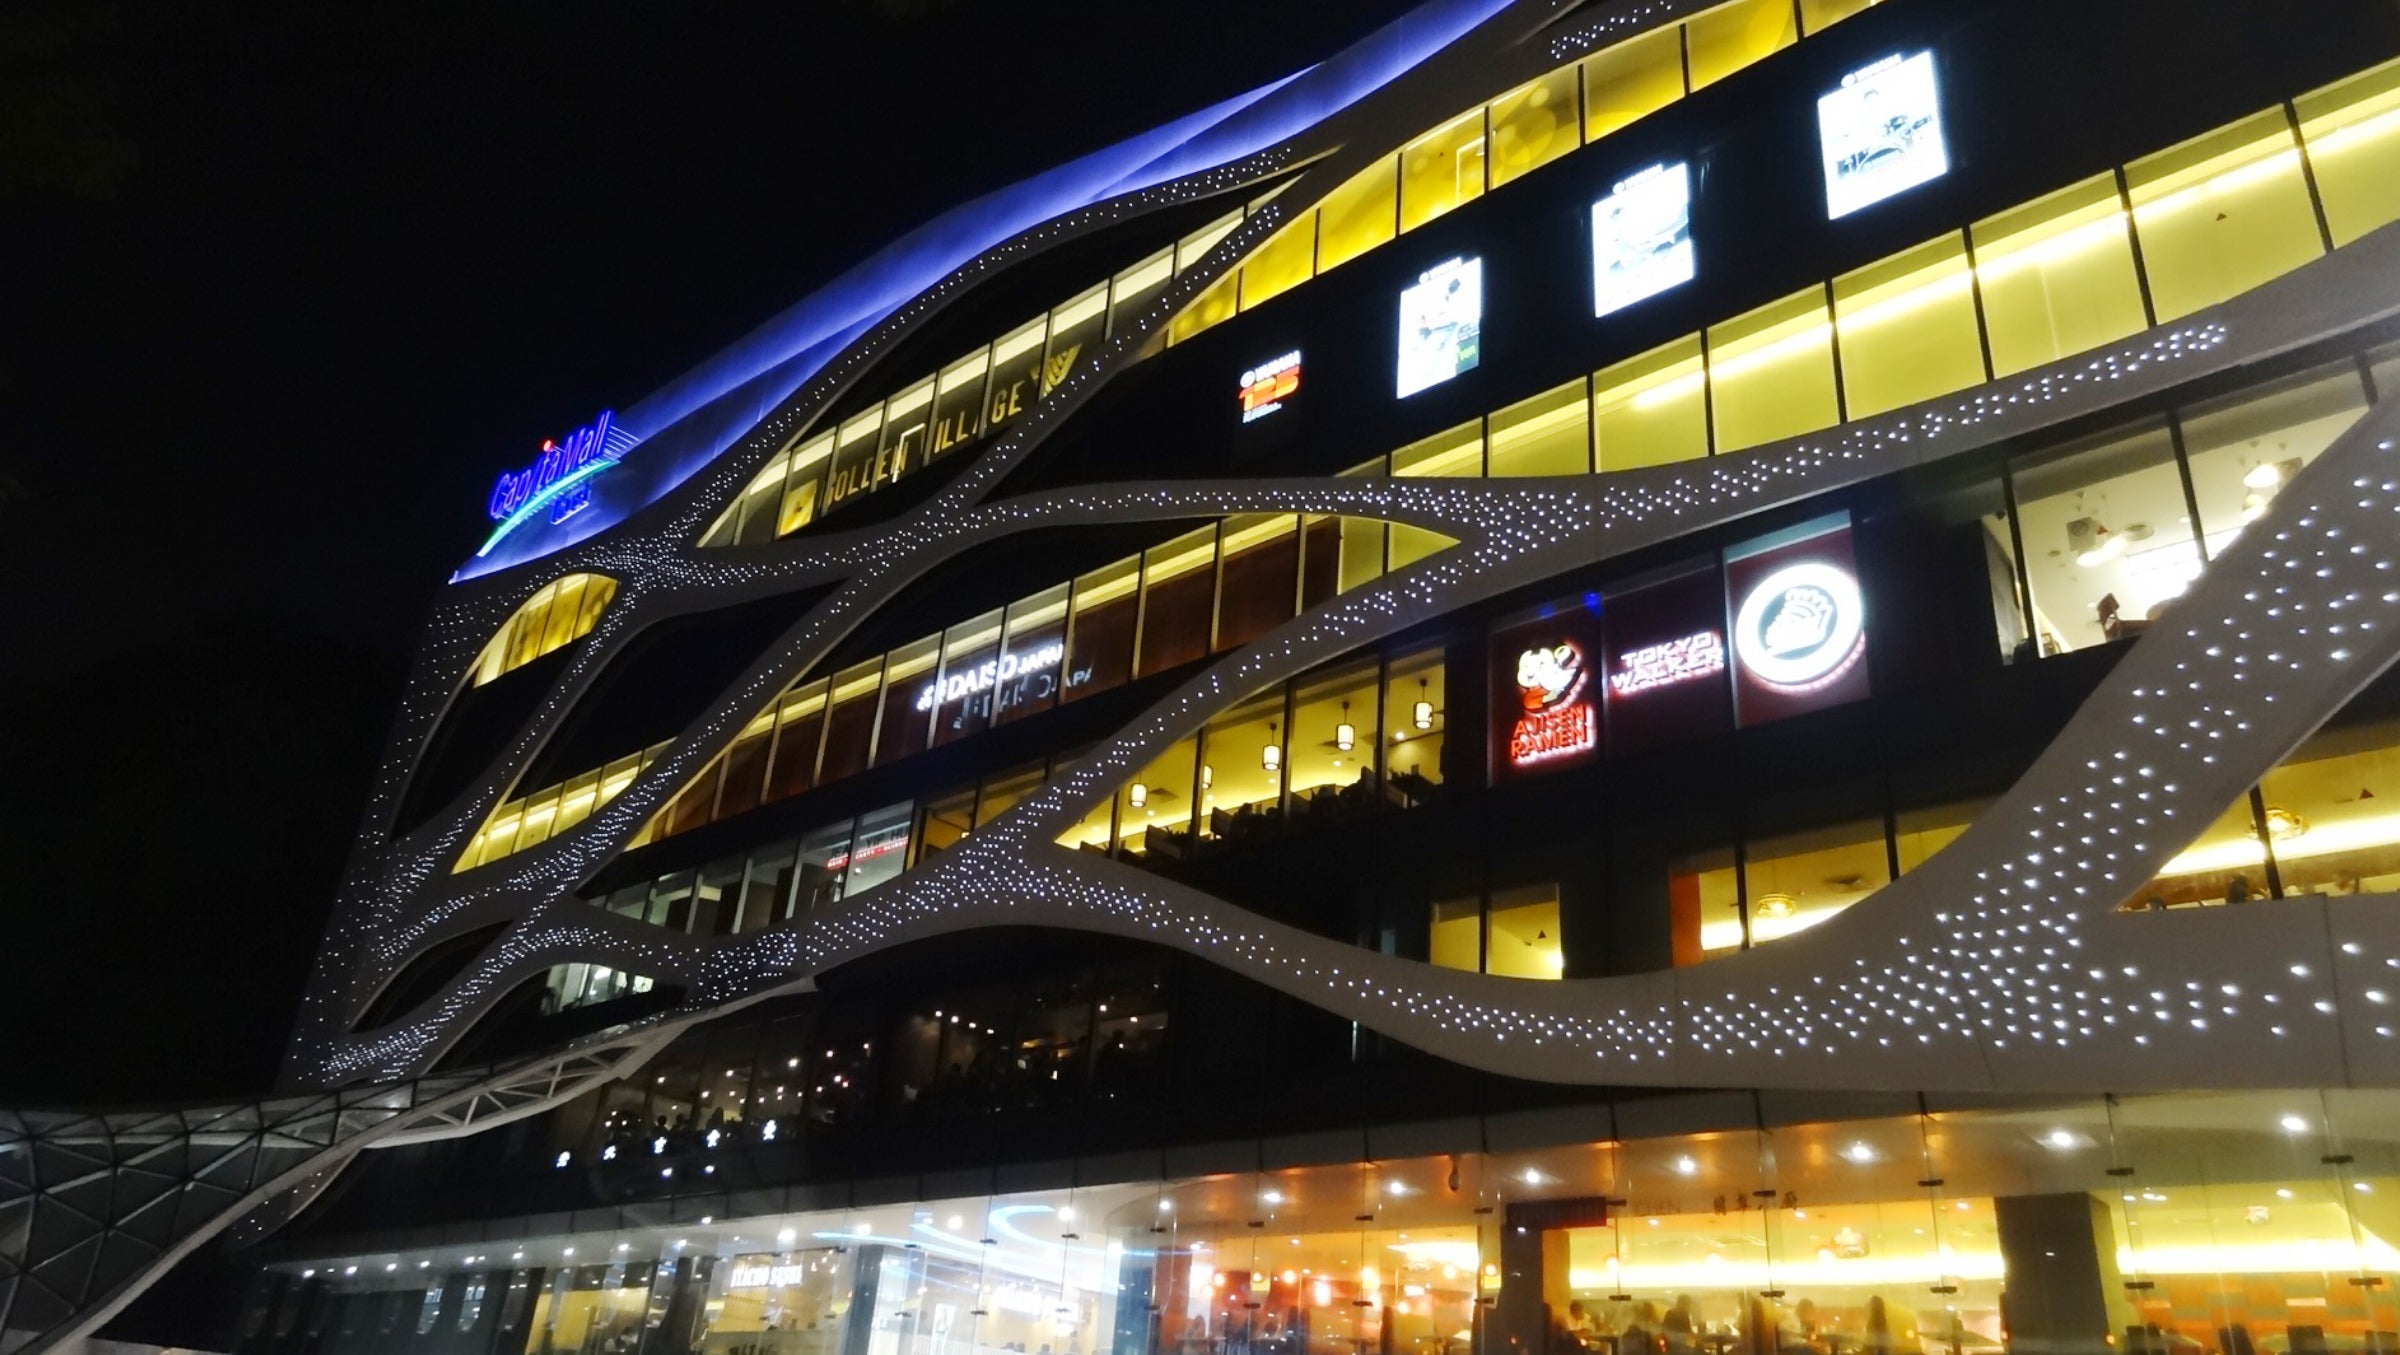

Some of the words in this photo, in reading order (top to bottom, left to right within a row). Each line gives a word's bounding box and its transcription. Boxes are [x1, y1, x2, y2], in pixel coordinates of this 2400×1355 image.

[1620, 631, 1713, 668] TOKYO
[946, 653, 1018, 701] DAISO
[1610, 647, 1724, 691] WALKER
[1512, 705, 1587, 738] AJISEN
[1510, 724, 1588, 758] RAMEN
